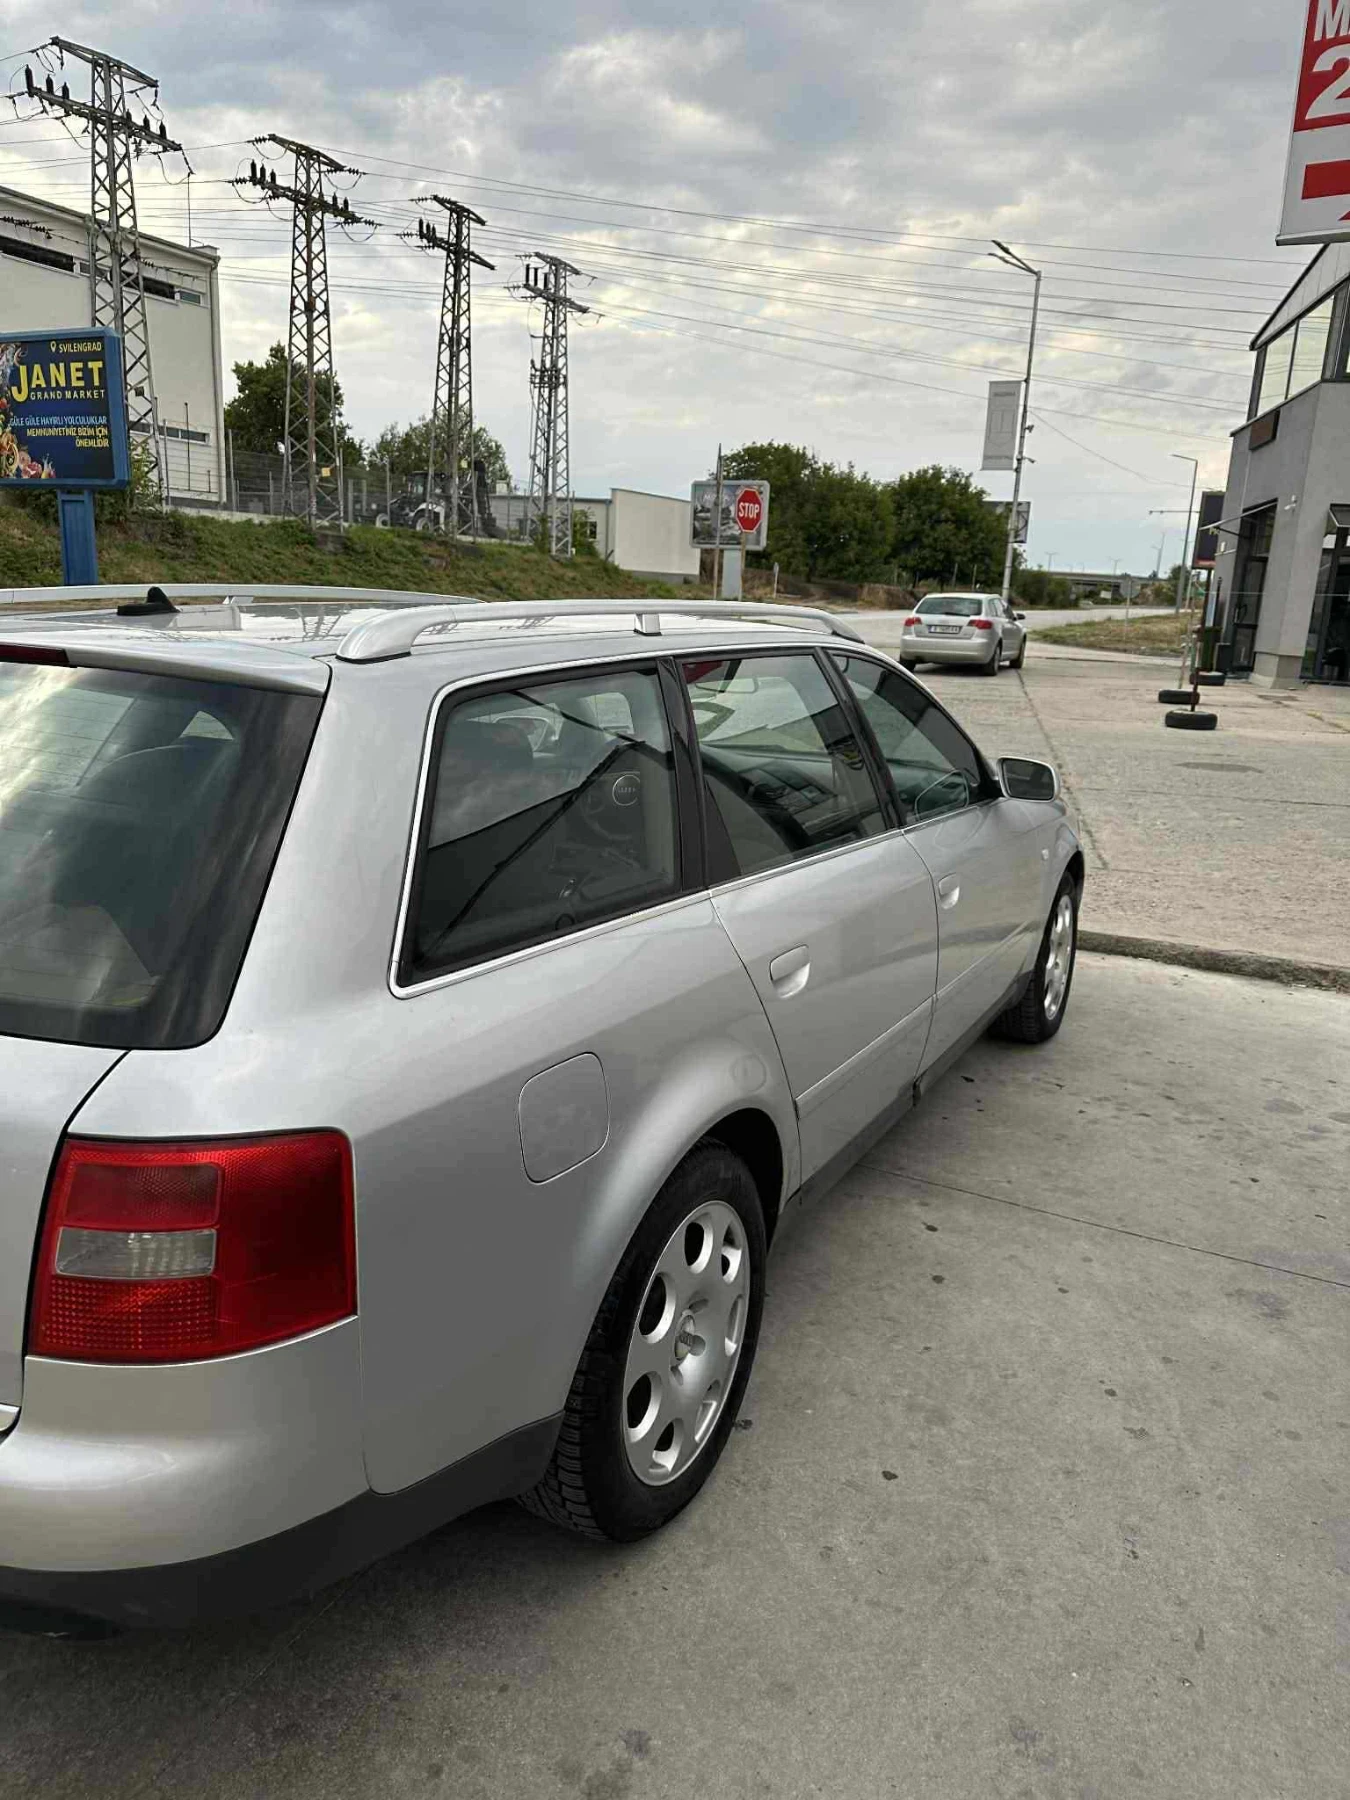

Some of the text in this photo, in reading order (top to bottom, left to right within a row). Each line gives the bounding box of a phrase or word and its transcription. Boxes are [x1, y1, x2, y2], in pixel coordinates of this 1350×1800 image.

[59, 341, 102, 353] SVILENGRAD
[11, 361, 103, 402] JANET
[30, 389, 105, 400] GRAND MARKET
[738, 502, 760, 519] STOP
